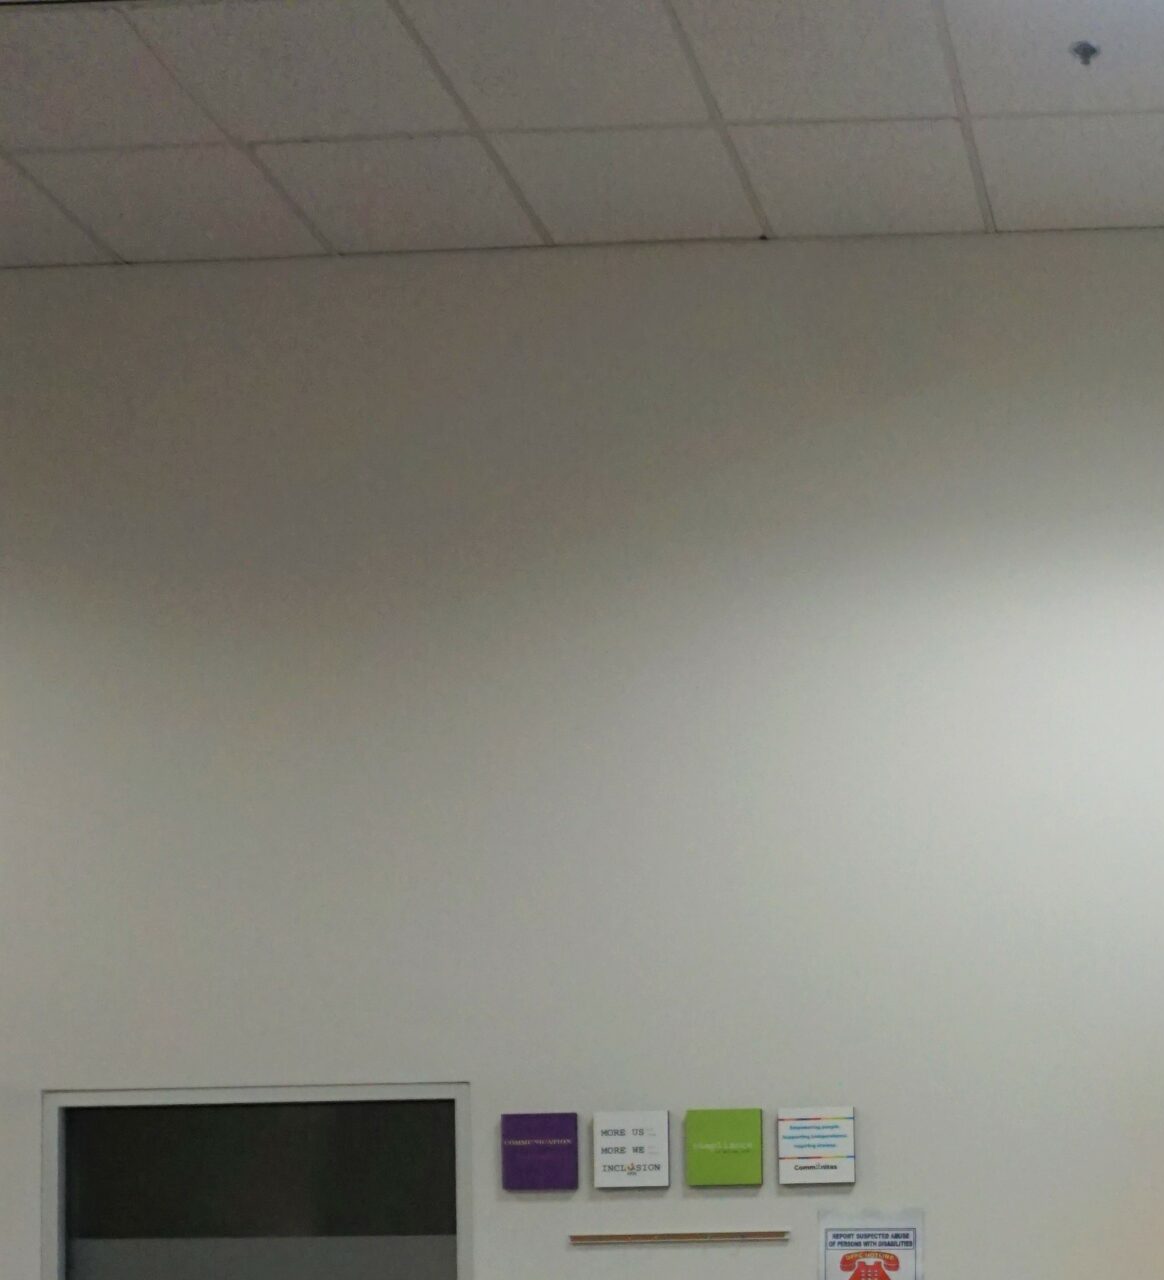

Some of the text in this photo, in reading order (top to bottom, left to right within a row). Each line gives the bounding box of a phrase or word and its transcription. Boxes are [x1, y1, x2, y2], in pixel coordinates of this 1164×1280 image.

[600, 1128, 626, 1137] MORE
[632, 1128, 645, 1136] US
[600, 1146, 626, 1154] MORE
[632, 1146, 645, 1154] WE
